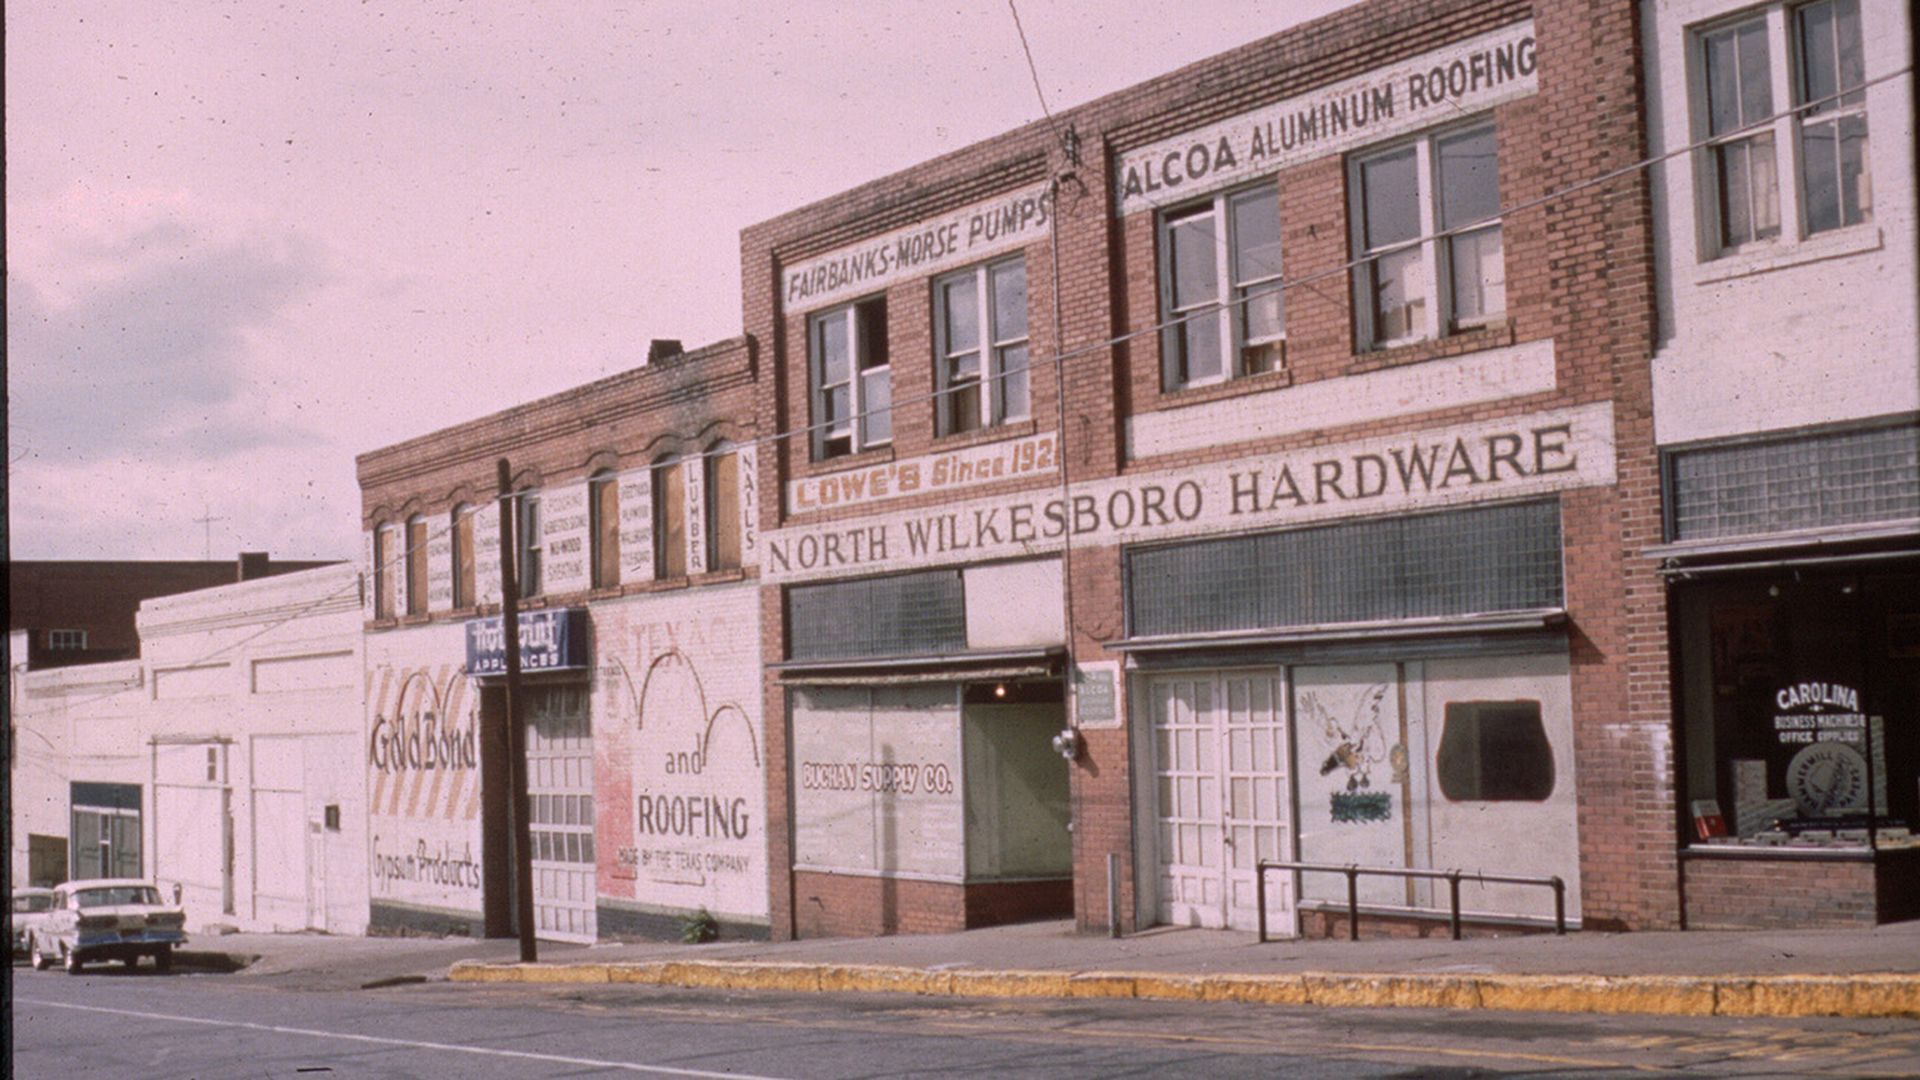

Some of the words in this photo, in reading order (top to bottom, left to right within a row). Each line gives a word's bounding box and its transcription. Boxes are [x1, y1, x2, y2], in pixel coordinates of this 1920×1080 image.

[1123, 136, 1237, 200] ALCOA
[1250, 82, 1395, 161] ALUMINUM
[1408, 36, 1537, 111] ROOFING
[787, 222, 959, 302] FAIRBANKS-MORSE
[968, 192, 1053, 247] PUMPS
[743, 454, 755, 551] NAILS
[769, 525, 888, 575] NORTH
[905, 480, 1202, 557] WILKESBORO
[1230, 423, 1579, 516] HARDWARE
[796, 463, 922, 507] LOWE'S
[931, 456, 1007, 487] Since
[688, 463, 702, 569] LUMBER
[472, 612, 558, 652] Hotoint
[474, 652, 559, 671] APPLNCES
[1777, 682, 1859, 712] CAROLINA
[1774, 714, 1816, 730] BUSINESS
[1779, 731, 1814, 743] OFFICE
[665, 733, 702, 775] and
[862, 763, 919, 794] SUPPLY
[923, 763, 954, 794] CO.
[638, 794, 749, 840] ROOFING
[372, 834, 417, 894] Gypsum
[417, 838, 480, 889] Products
[655, 850, 671, 869] THE
[674, 851, 702, 871] TEXAS
[705, 853, 749, 873] COMPANY
